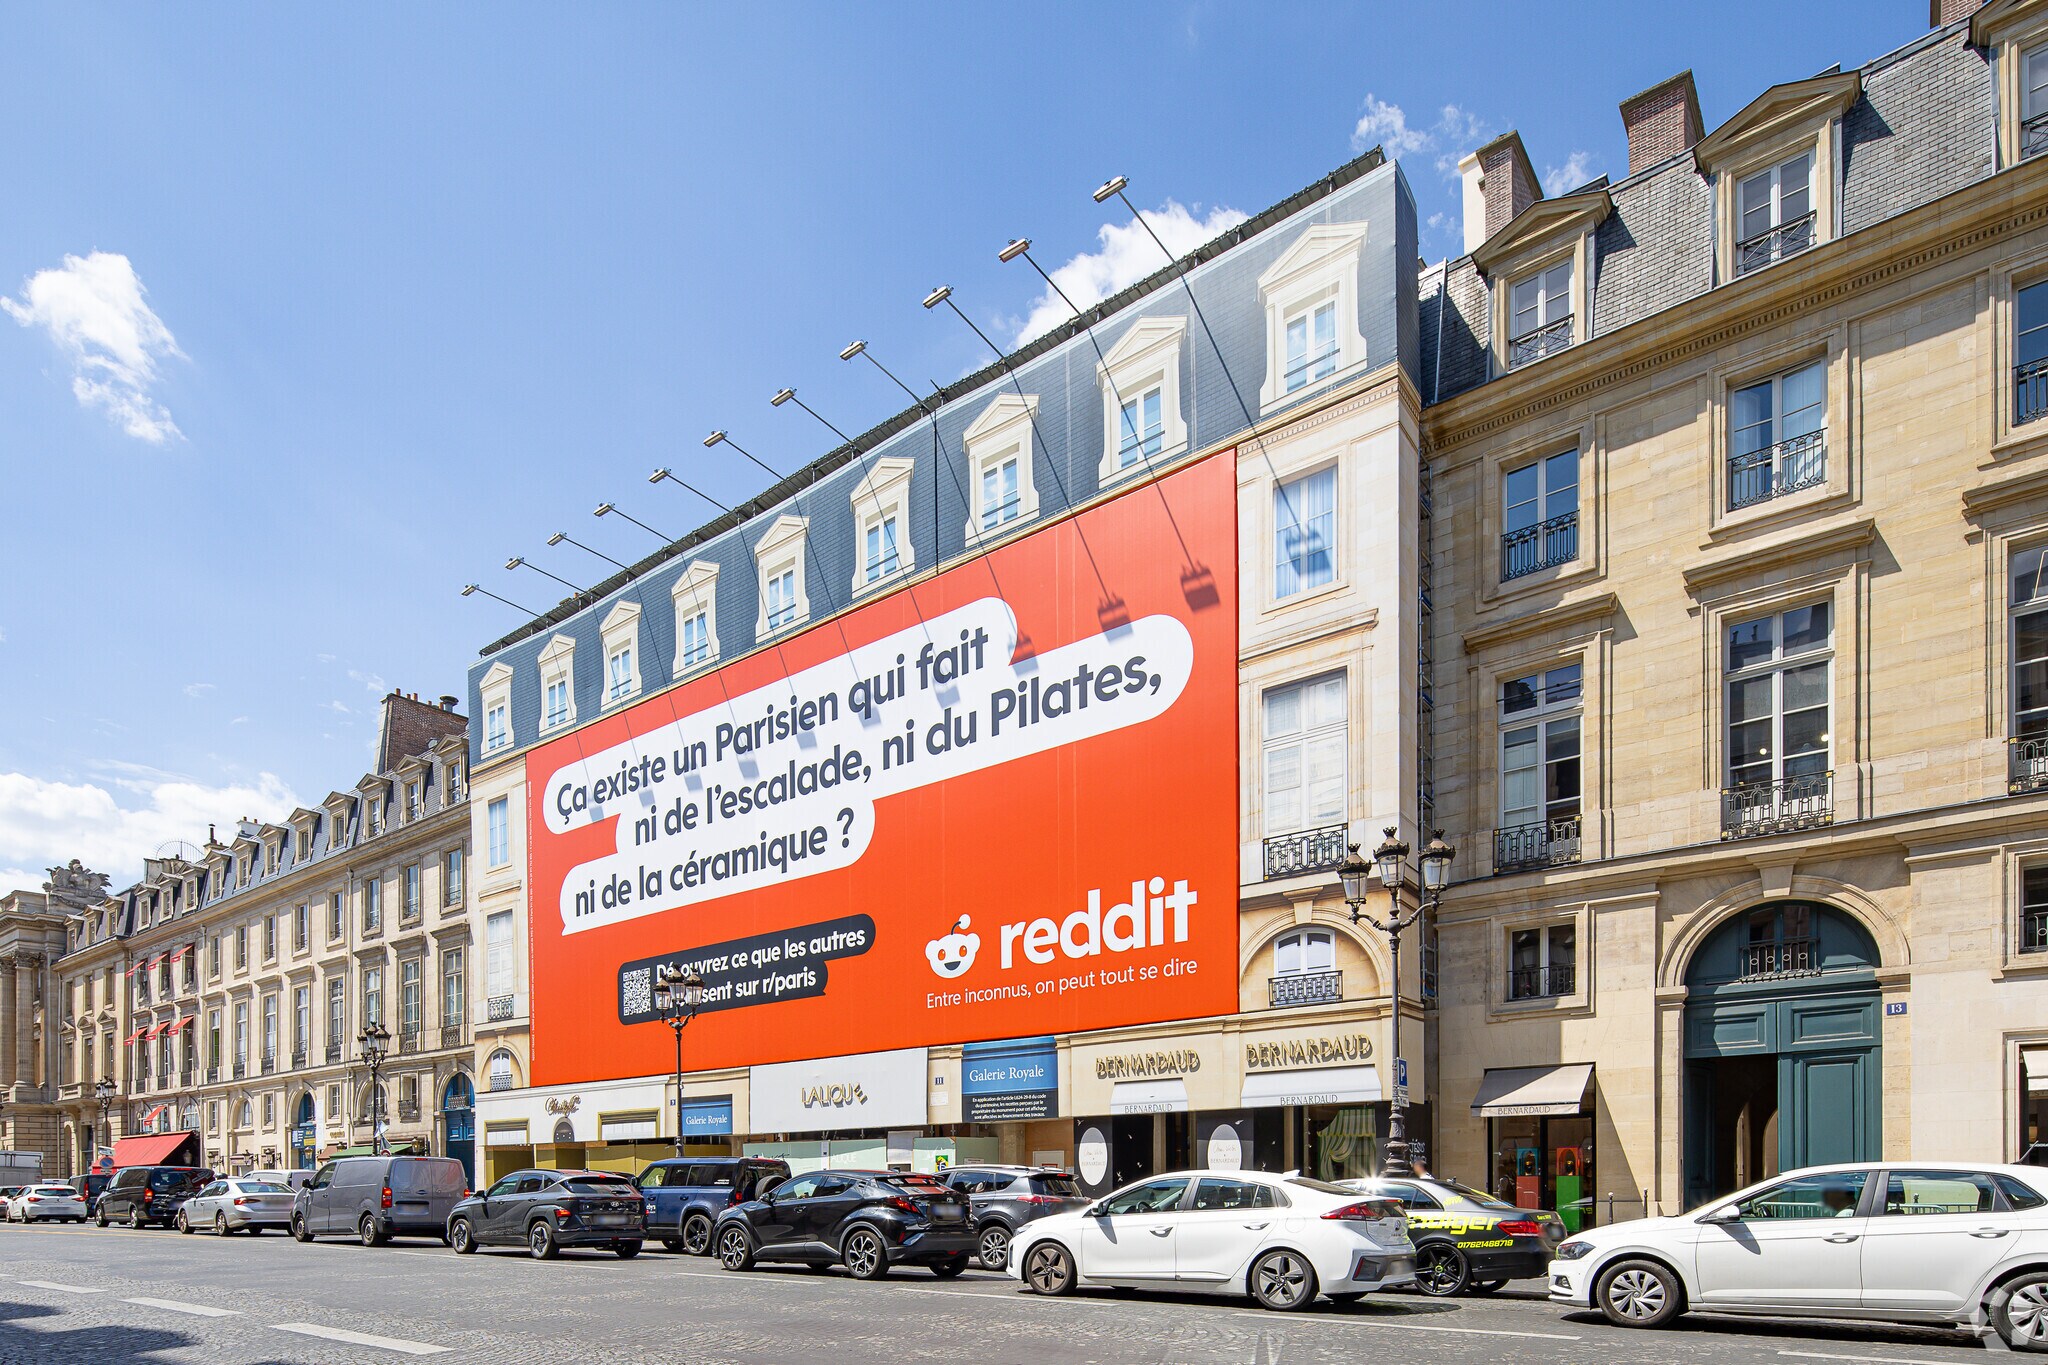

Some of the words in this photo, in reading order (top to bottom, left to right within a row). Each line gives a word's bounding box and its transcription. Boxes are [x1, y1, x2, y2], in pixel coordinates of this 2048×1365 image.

[556, 783, 587, 825] Ça
[593, 755, 666, 805] existe
[673, 740, 707, 776] un
[715, 694, 838, 763] Parisien
[849, 653, 905, 720] qui
[915, 626, 988, 690] fait
[635, 804, 657, 846] ni
[664, 796, 699, 836] de
[706, 743, 872, 824] l’escalade,
[882, 718, 914, 771] ni
[926, 707, 977, 755] du
[991, 655, 1162, 737] Pilates,
[575, 879, 595, 917] ni
[601, 873, 632, 910] de
[639, 865, 663, 901] la
[669, 825, 828, 892] céramique
[1000, 876, 1198, 970] reddit
[656, 955, 729, 984] Déouvrez
[731, 952, 748, 969] ce
[751, 945, 781, 969] que
[784, 938, 806, 960] les
[809, 929, 866, 955] autres
[735, 979, 760, 998] sur
[762, 966, 817, 998] r/paris
[926, 992, 962, 1009] Entre
[964, 982, 1032, 1003] inconnus,
[1035, 978, 1055, 995] on
[1059, 973, 1096, 996] peut
[1099, 967, 1135, 986] tout
[1139, 963, 1158, 980] se
[1163, 957, 1198, 977] dire
[1890, 1003, 1903, 1014] 13
[1095, 1048, 1200, 1079] BERNARDAUD
[1245, 1034, 1374, 1068] BERNARDAUD
[969, 1068, 1006, 1082] Galerie
[1008, 1064, 1044, 1082] Royale
[801, 1082, 869, 1108] LALIQUE
[1124, 1103, 1173, 1114] BERNARDAUD
[1280, 1094, 1338, 1106] BERNARDAUD
[1497, 1105, 1551, 1115] BERNARDAUD
[686, 1115, 707, 1125] Galerie
[708, 1113, 728, 1125] Royale
